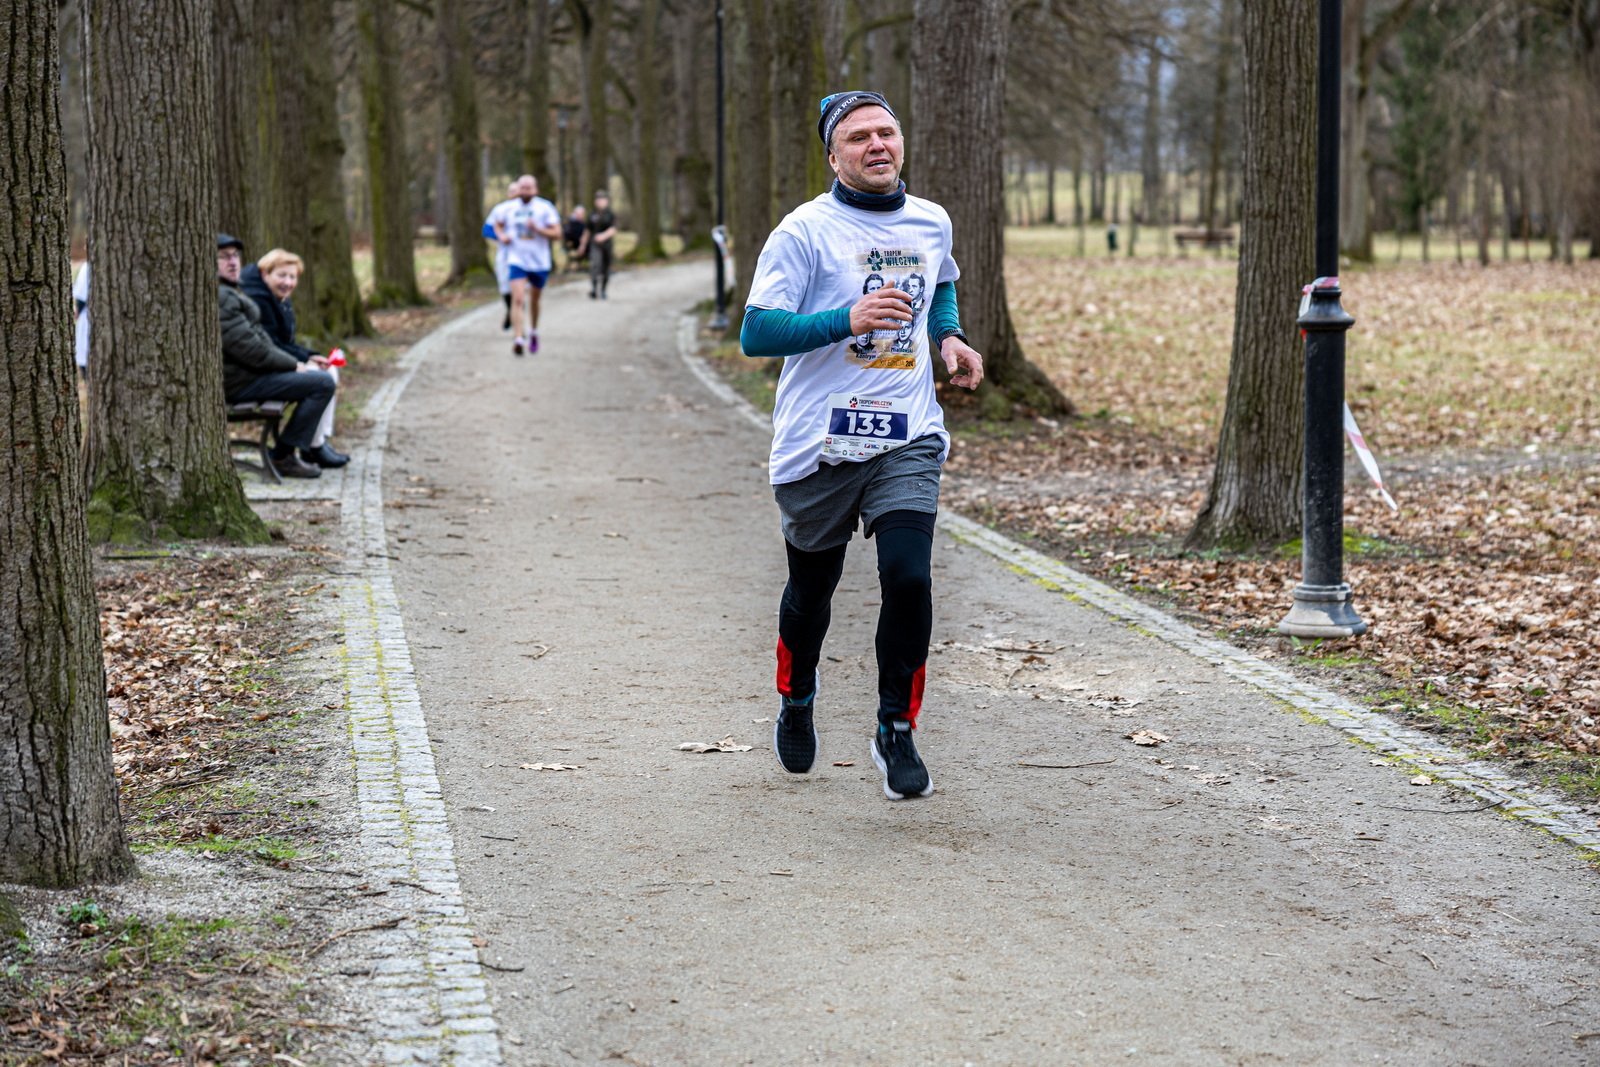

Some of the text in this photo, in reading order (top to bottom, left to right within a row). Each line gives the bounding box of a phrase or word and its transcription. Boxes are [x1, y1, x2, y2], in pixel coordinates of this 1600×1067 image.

[841, 96, 858, 108] RUN
[885, 256, 919, 267] WILCZYM
[846, 411, 892, 437] 133
